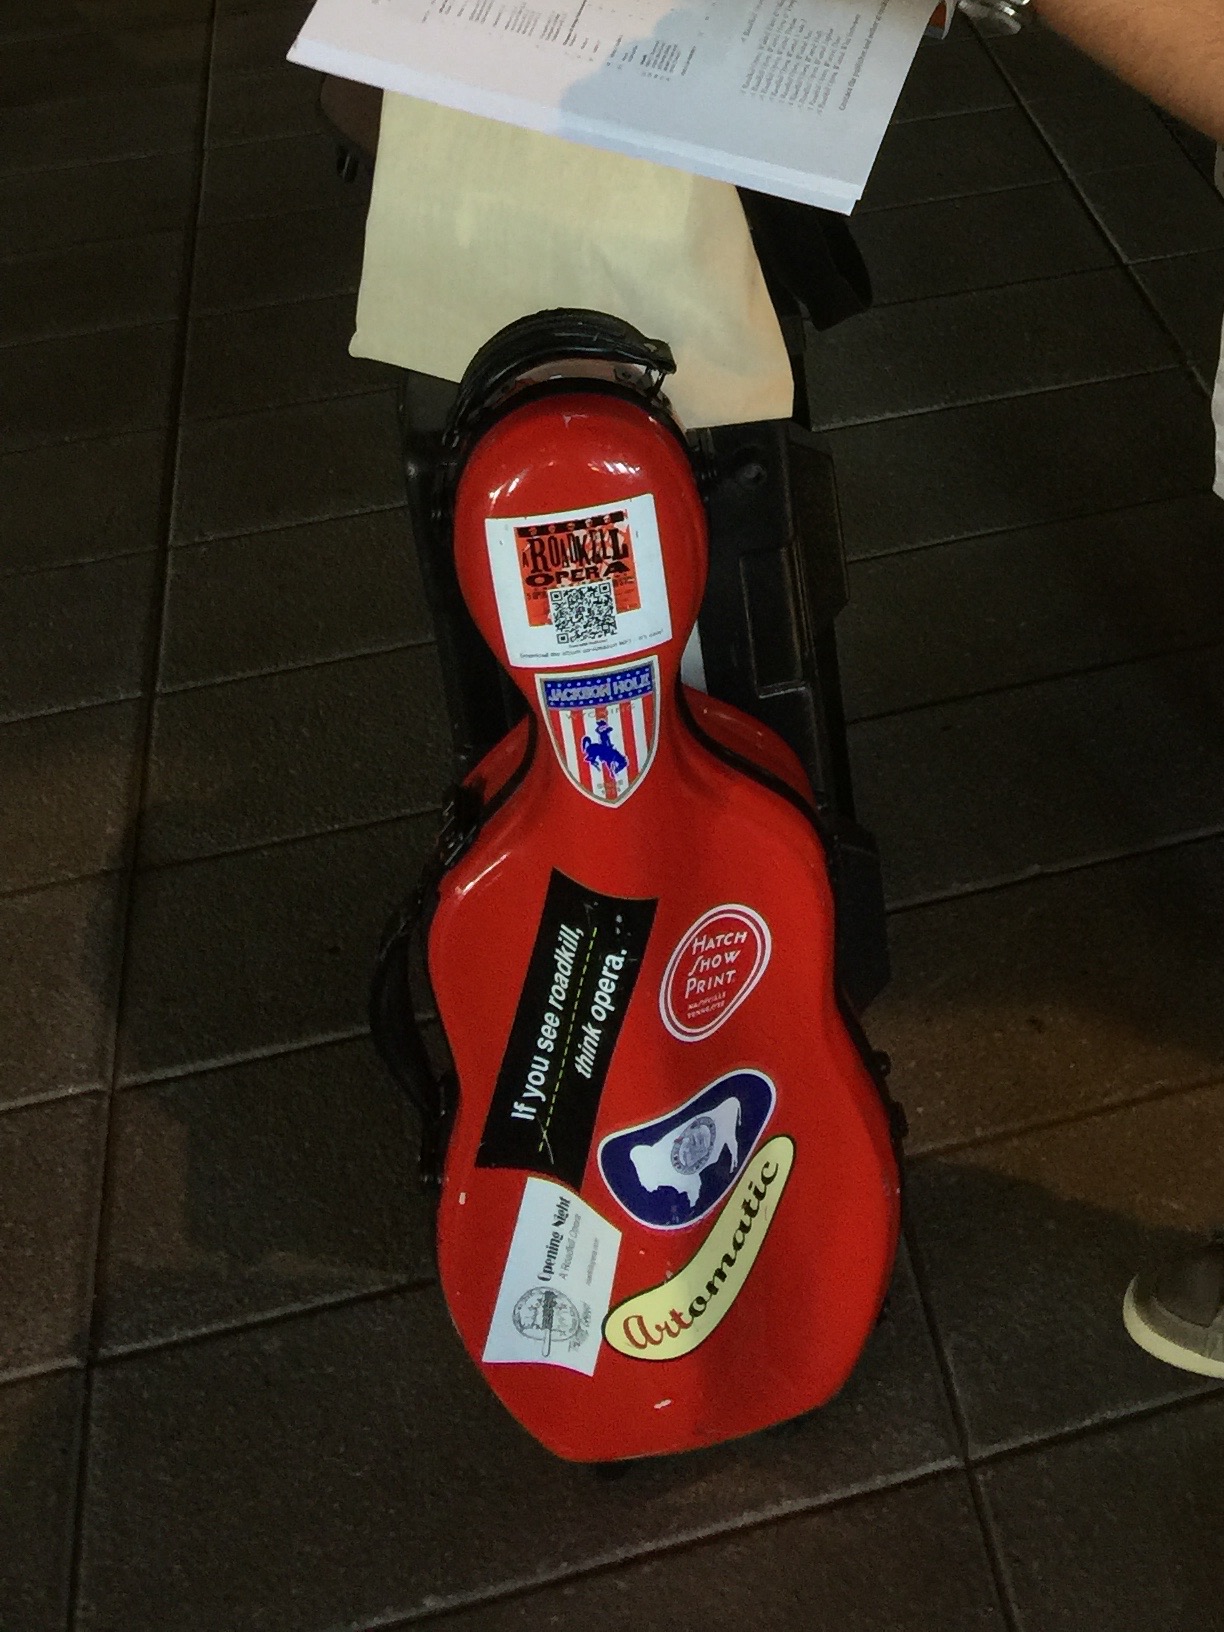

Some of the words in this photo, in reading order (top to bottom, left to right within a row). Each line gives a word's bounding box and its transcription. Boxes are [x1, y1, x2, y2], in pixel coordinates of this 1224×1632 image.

[522, 551, 530, 568] A
[529, 528, 630, 574] ROADKILL
[525, 561, 631, 588] OPERA
[549, 682, 612, 701] JACKSON
[613, 672, 651, 694] HOLE
[692, 931, 748, 955] HATCH
[548, 923, 585, 1011] roadkill,
[688, 950, 742, 977] SHOW
[685, 969, 737, 999] PRINT
[574, 1021, 603, 1079] think
[591, 948, 629, 1022] opera.
[537, 1011, 561, 1053] see
[522, 1055, 551, 1103] you
[510, 1101, 537, 1121] If
[537, 1231, 565, 1282] Opening
[551, 1196, 573, 1228] Night
[623, 1160, 779, 1350] Artomatic
[559, 1271, 568, 1280] A
